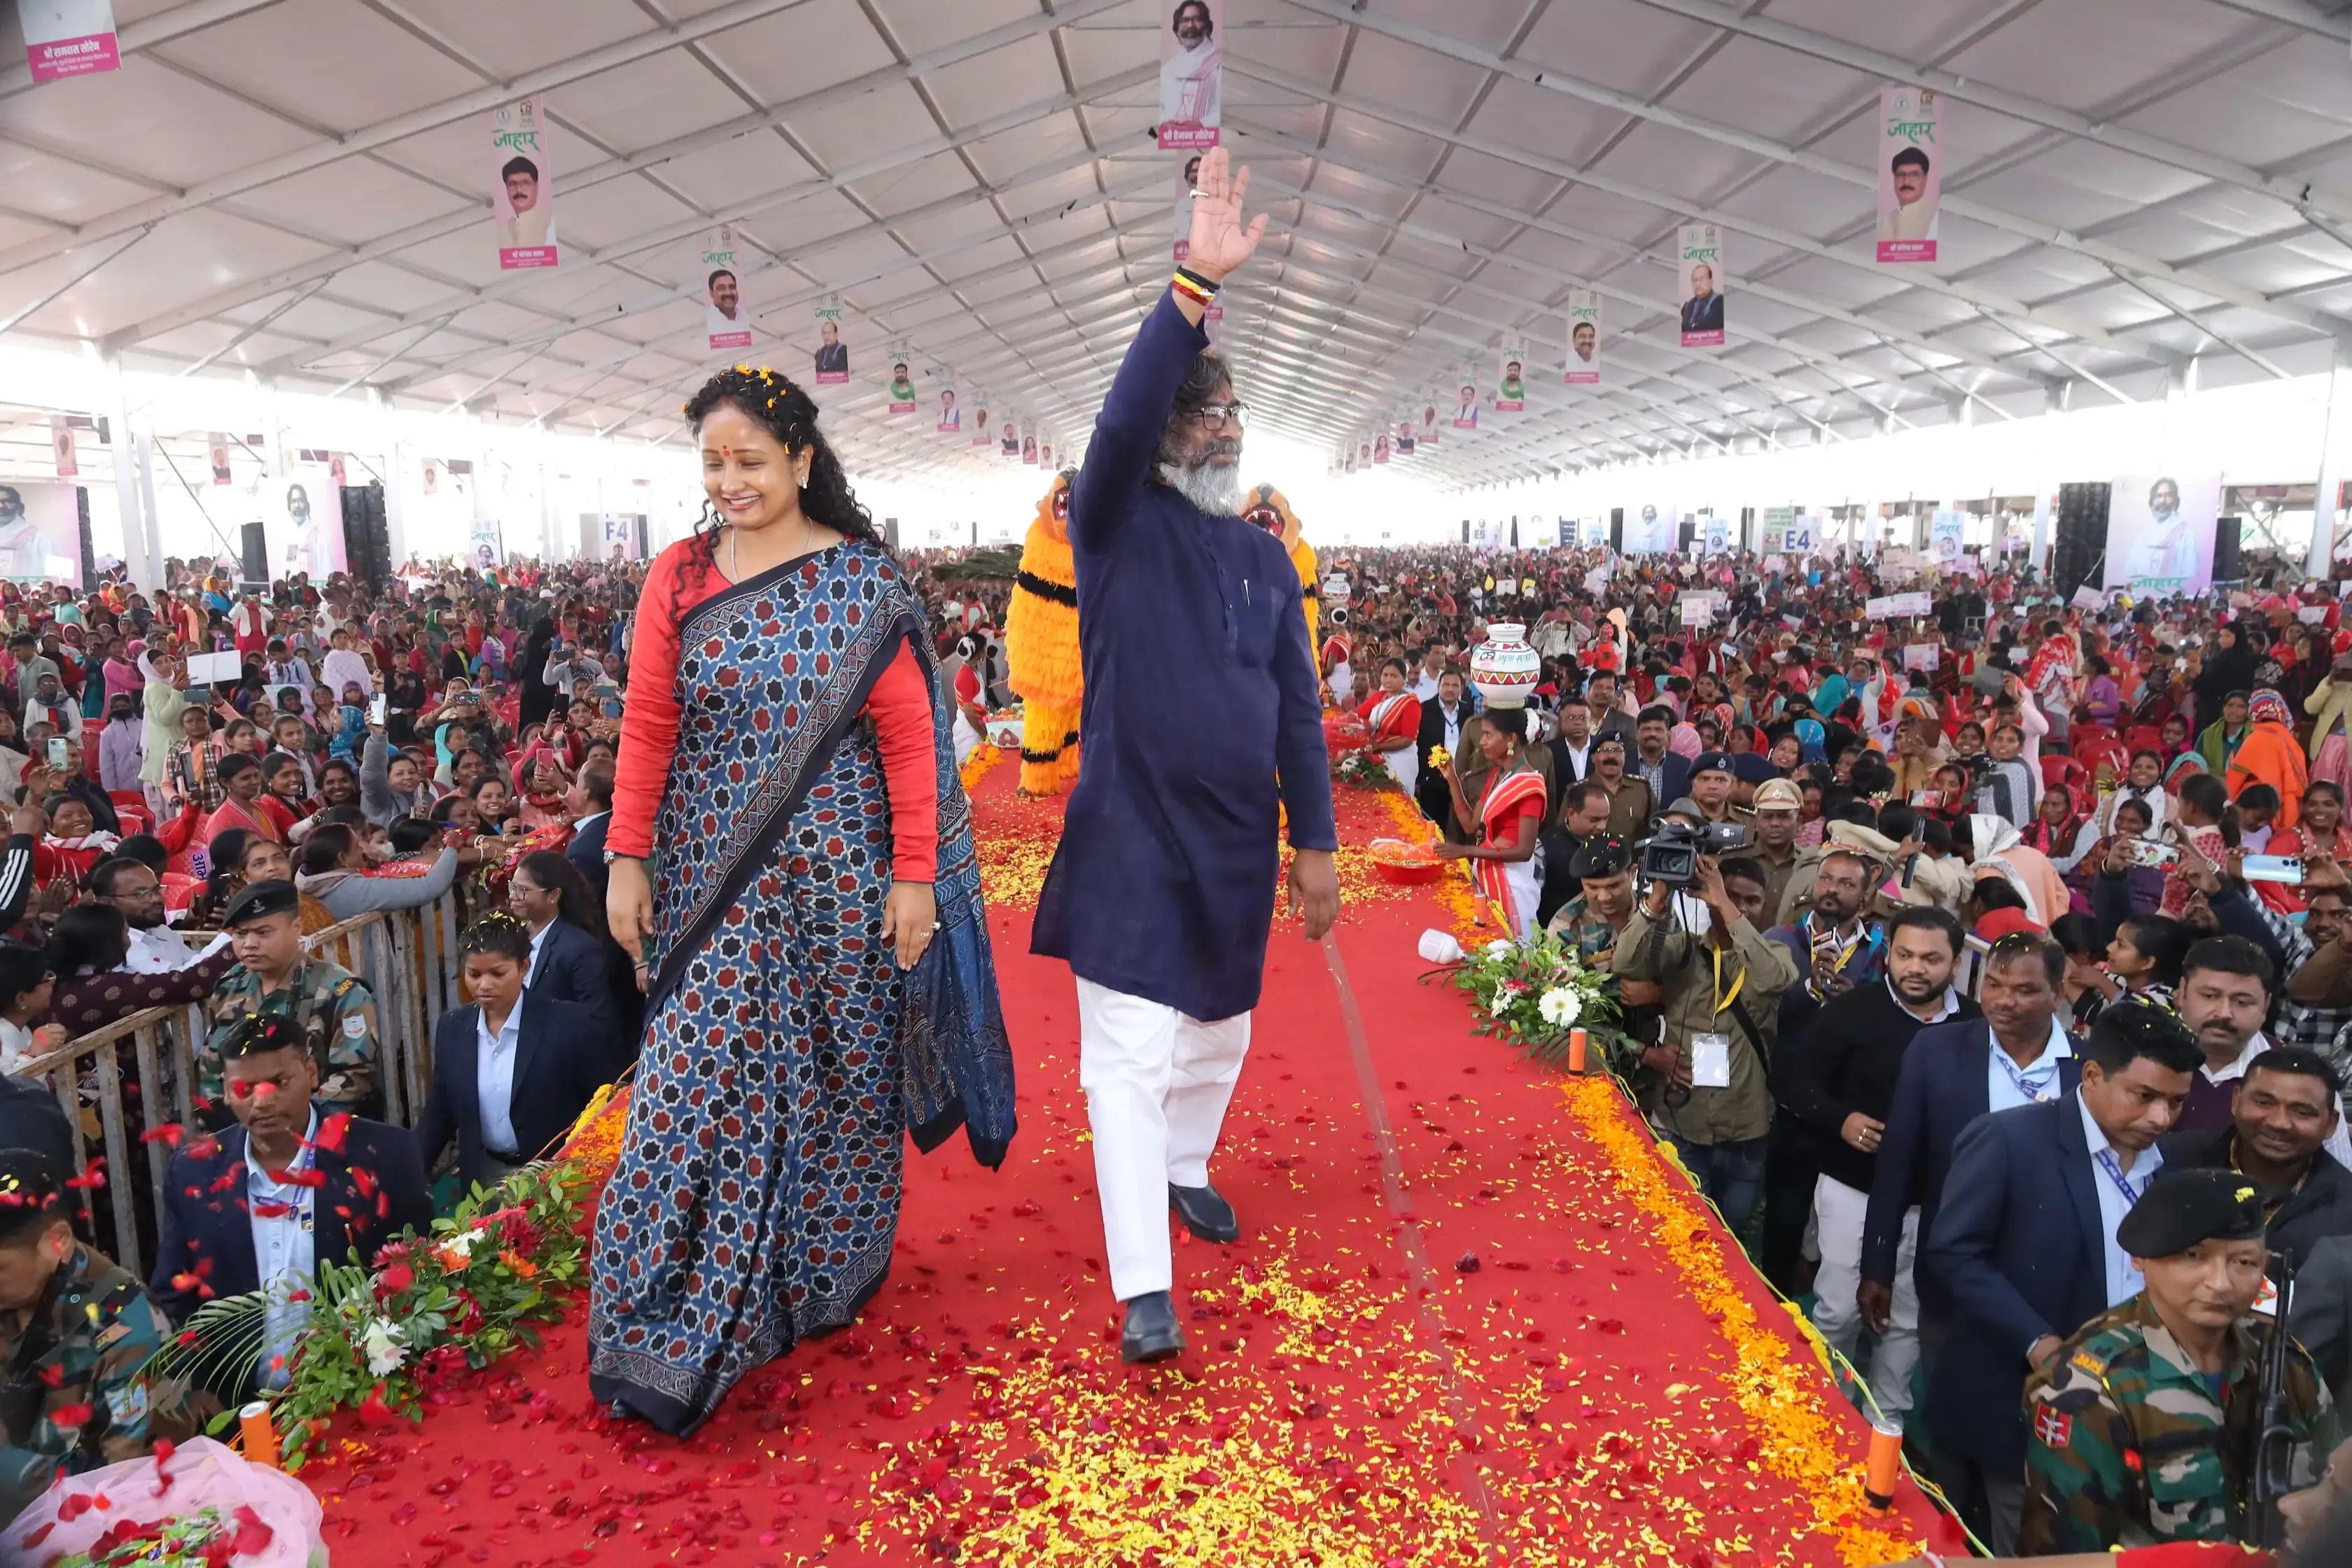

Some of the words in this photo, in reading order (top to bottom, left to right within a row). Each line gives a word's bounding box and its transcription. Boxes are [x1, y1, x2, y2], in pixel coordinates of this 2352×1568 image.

[43, 46, 53, 59] श्री
[80, 39, 100, 53] सोरेन
[491, 129, 541, 153] जोहार
[1163, 130, 1172, 141] श्री
[1195, 129, 1215, 140] सोरेन
[1887, 118, 1938, 144] जोहार
[701, 251, 739, 267] जोहार
[1683, 246, 1720, 263] जोहार
[606, 522, 629, 541] F4
[1786, 530, 1810, 550] E4
[2128, 574, 2190, 595] जोहार
